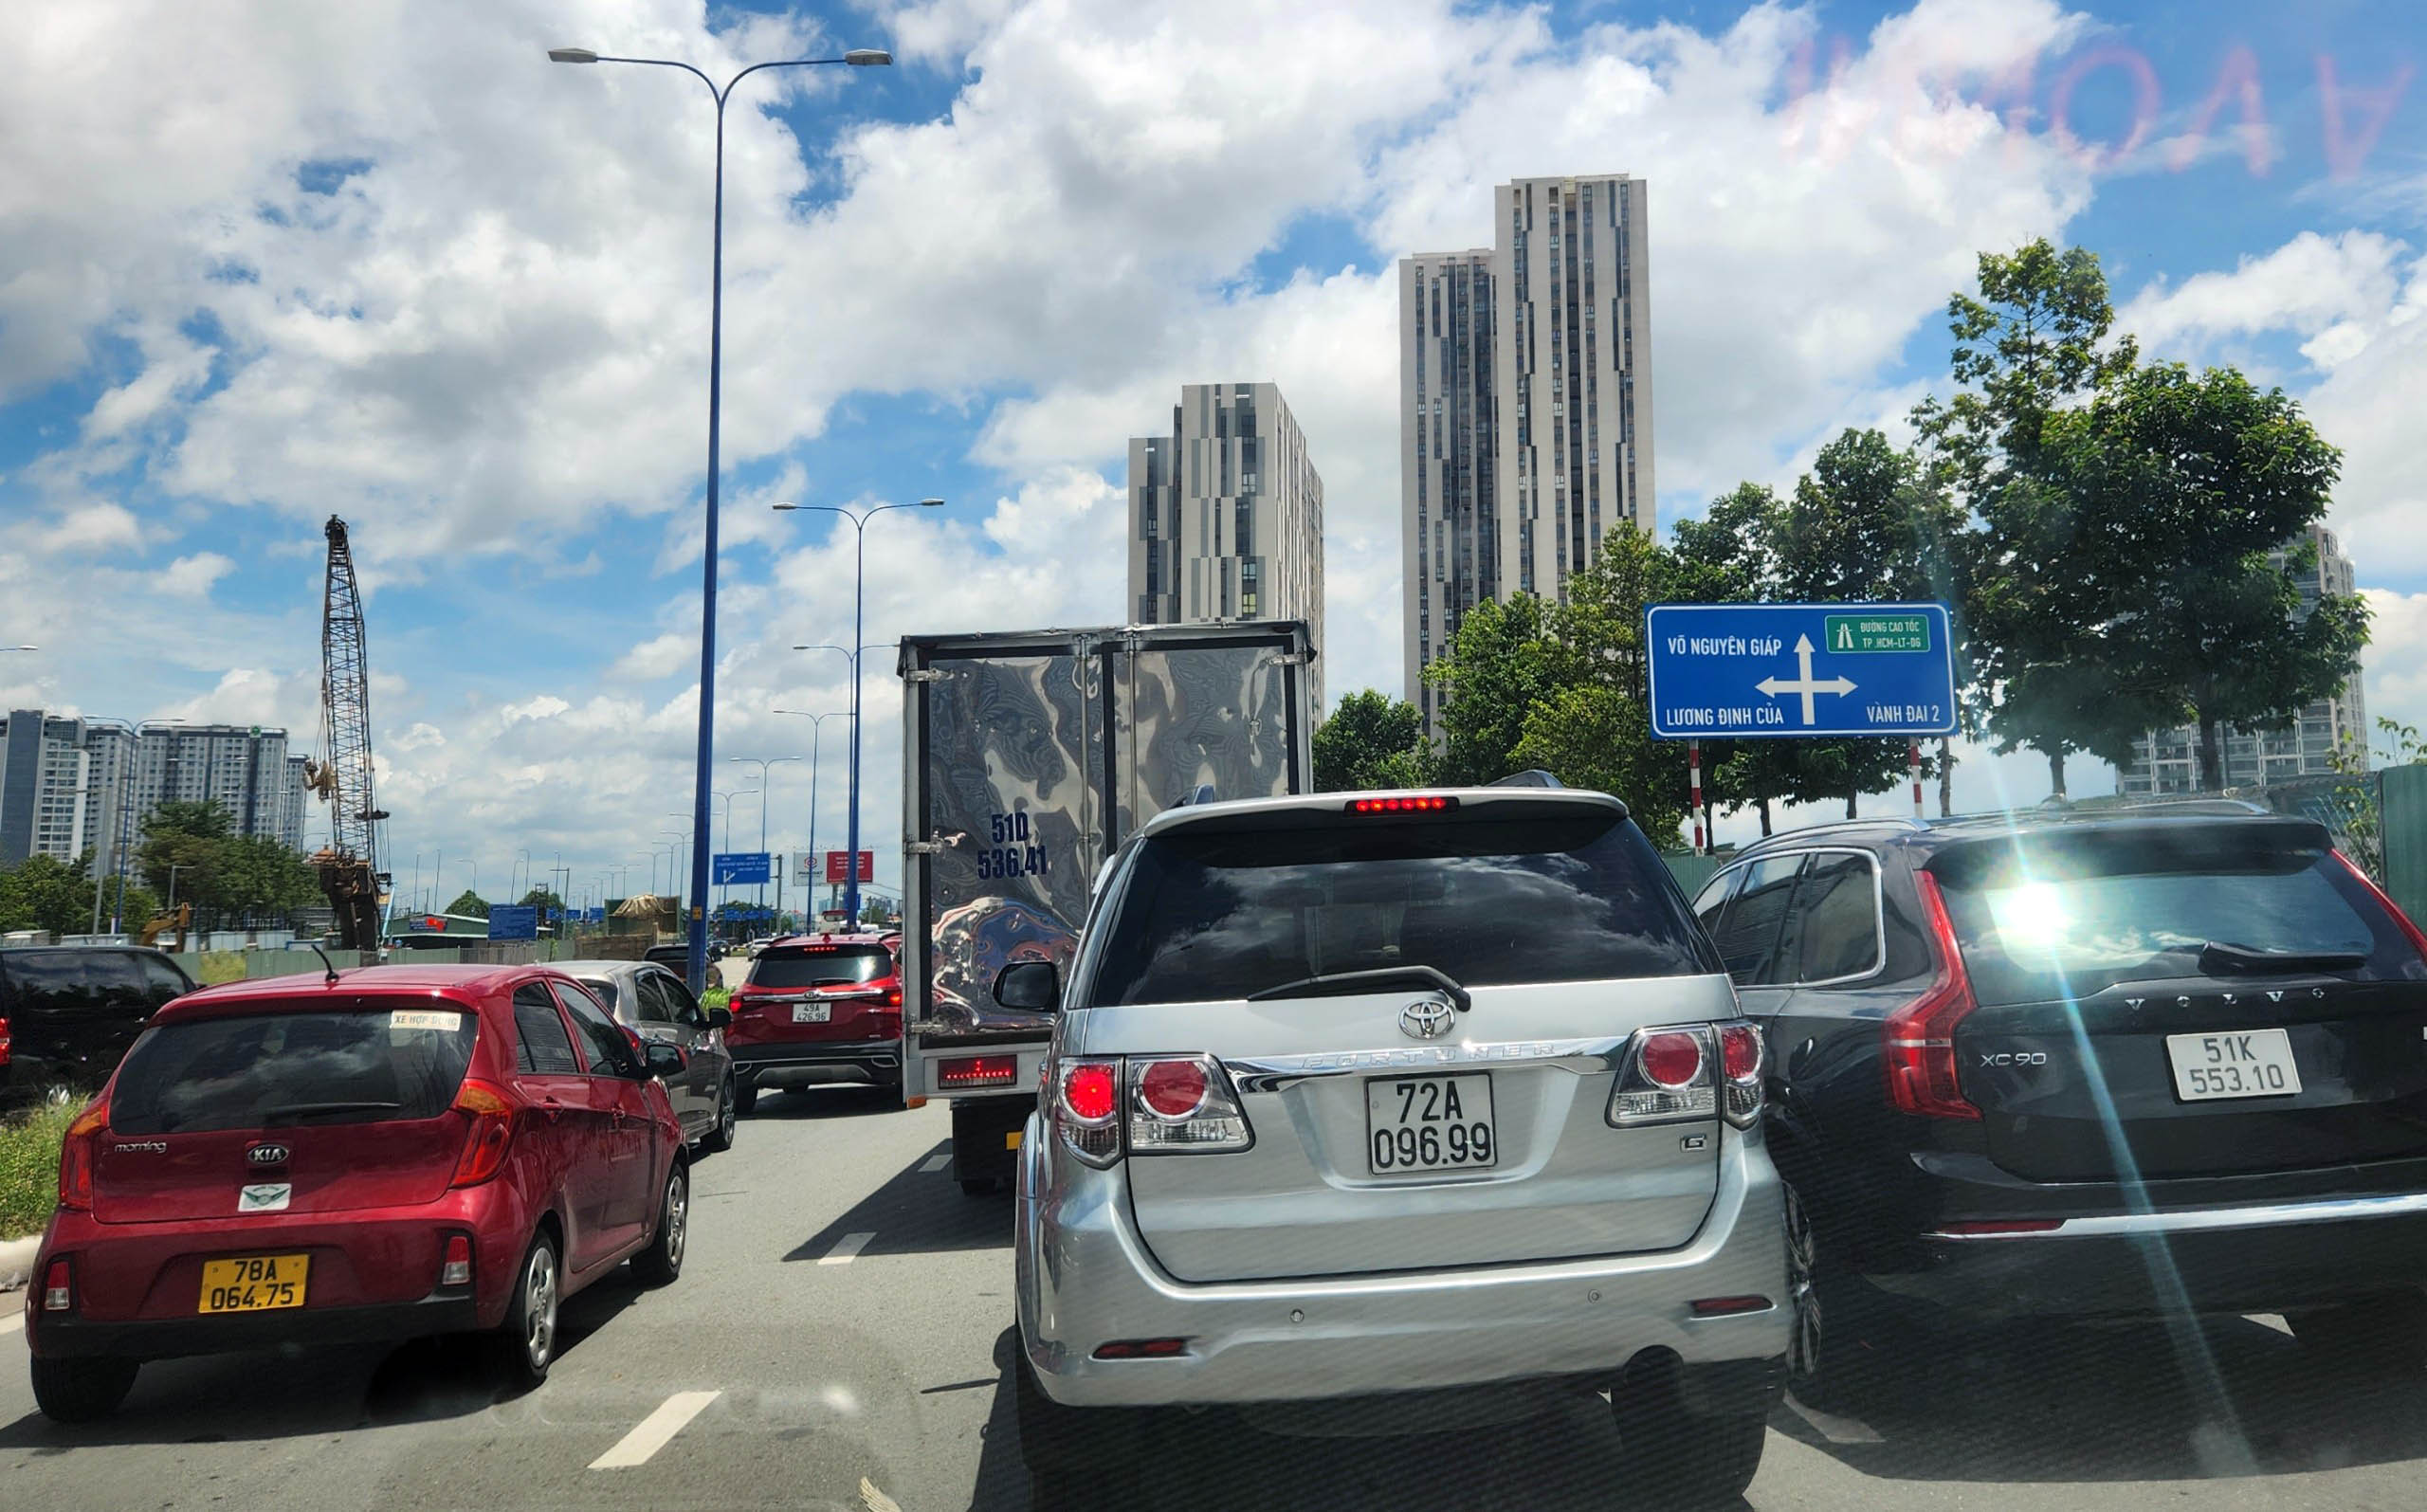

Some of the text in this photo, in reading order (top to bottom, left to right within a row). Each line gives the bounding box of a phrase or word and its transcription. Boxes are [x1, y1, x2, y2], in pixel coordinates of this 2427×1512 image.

[1889, 621, 1904, 632] CAO
[1668, 634, 1782, 656] VÕ NGUYÊN GIÁP
[1666, 701, 1784, 728] LƯƠNG ĐỊNH CỦA
[1867, 701, 1940, 723] VÀNH ĐAI 2
[992, 811, 1029, 844] 51D
[977, 845, 1047, 880] 536.41
[803, 1003, 820, 1012] 49A
[2126, 988, 2326, 1011] VOLVO
[1300, 1045, 1556, 1069] FORTUNER
[2202, 1035, 2256, 1063] 51K
[2189, 1064, 2285, 1094] 553.10
[1396, 1081, 1463, 1123] 72A
[115, 1141, 167, 1154] morning
[254, 1148, 283, 1161] KIA
[1375, 1122, 1492, 1169] 096.99
[234, 1259, 277, 1283] 78A
[210, 1282, 295, 1310] 064.75
